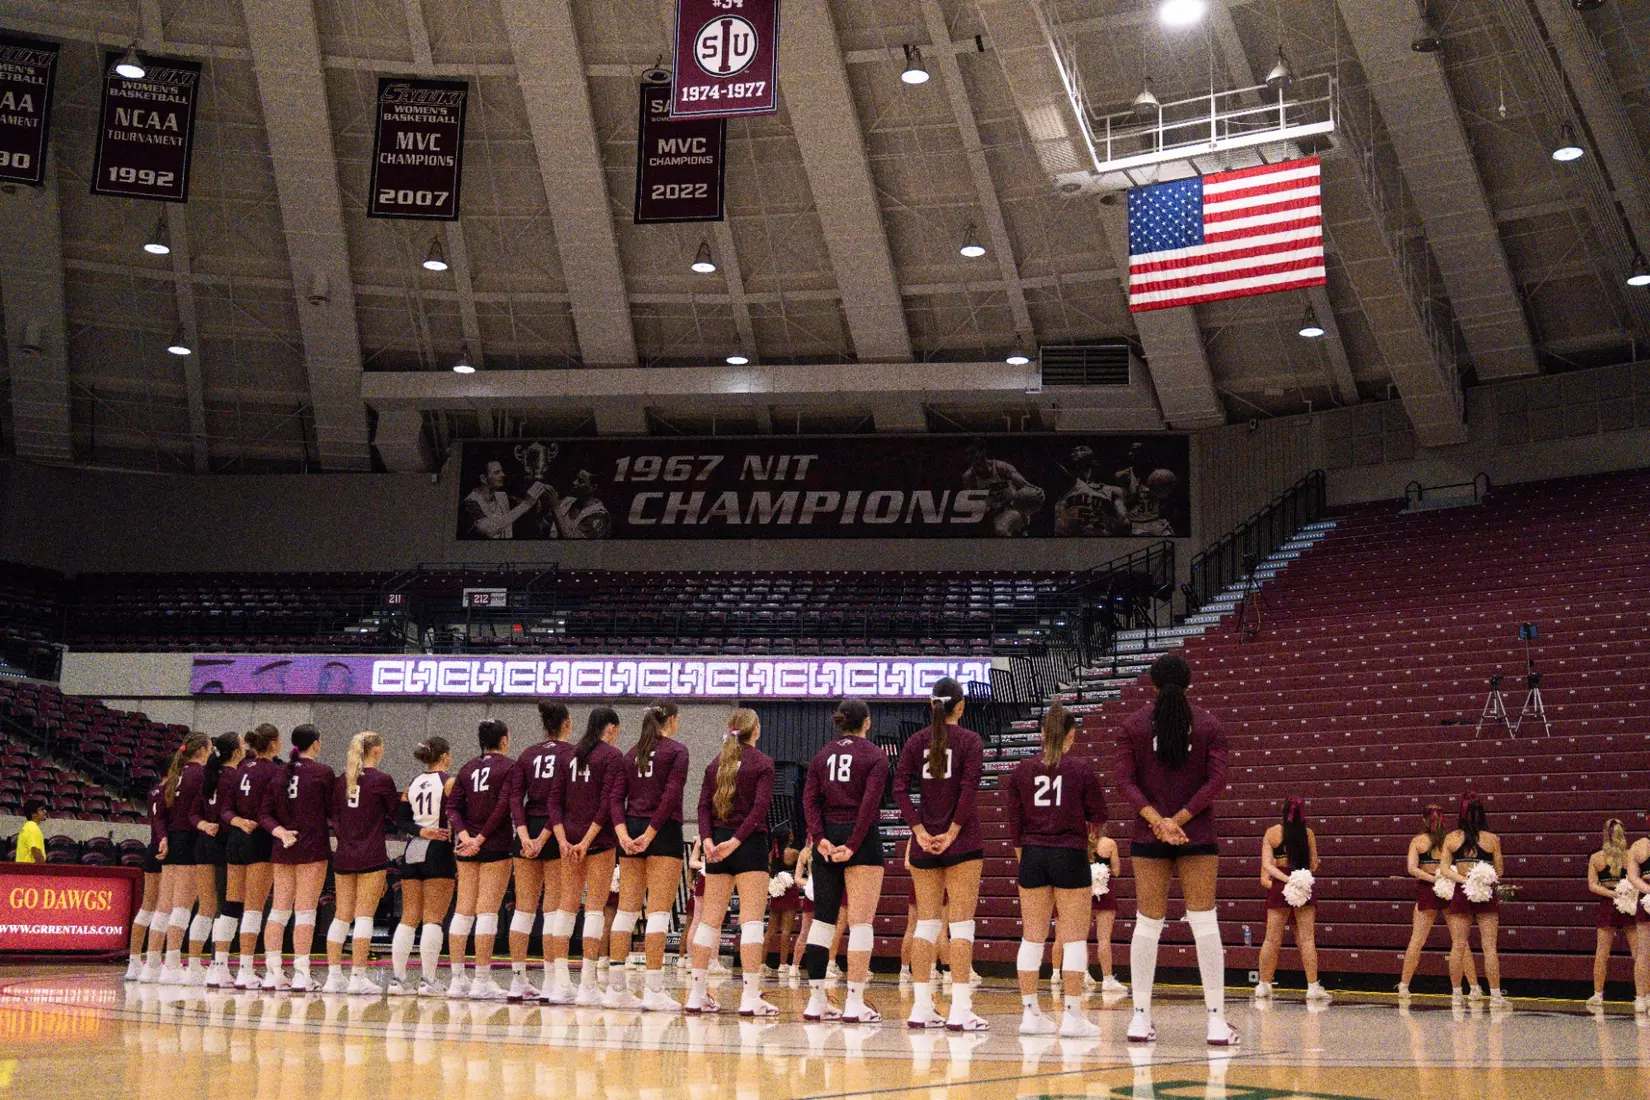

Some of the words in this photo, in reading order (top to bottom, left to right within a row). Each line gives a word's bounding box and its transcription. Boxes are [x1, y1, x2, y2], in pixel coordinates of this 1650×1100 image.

[109, 87, 189, 105] BASKETBALL
[121, 80, 179, 95] WOMEN'S
[682, 81, 766, 101] 1974-1977
[115, 107, 179, 132] NCAA
[383, 113, 458, 124] BASKETBALL
[394, 105, 448, 115] WOMEN'S
[107, 128, 184, 147] TOURNAMENT
[395, 131, 442, 151] MVC
[657, 137, 707, 154] MVC
[379, 152, 455, 167] CHAMPIONS
[649, 155, 714, 167] CHAMPIONS
[108, 166, 175, 187] 1992
[379, 188, 450, 207] 2007
[651, 183, 708, 200] 2022
[613, 455, 725, 482] 1967
[739, 454, 819, 481] NIT
[627, 490, 991, 525] CHAMPIONS
[473, 594, 489, 604] 212
[532, 755, 556, 779] 13
[826, 753, 853, 782] 18
[240, 773, 252, 796] 4
[470, 767, 491, 793] 12
[1034, 775, 1063, 807] 21
[415, 791, 433, 815] 11
[9, 887, 40, 909] GO
[42, 888, 113, 911] DAWGS!
